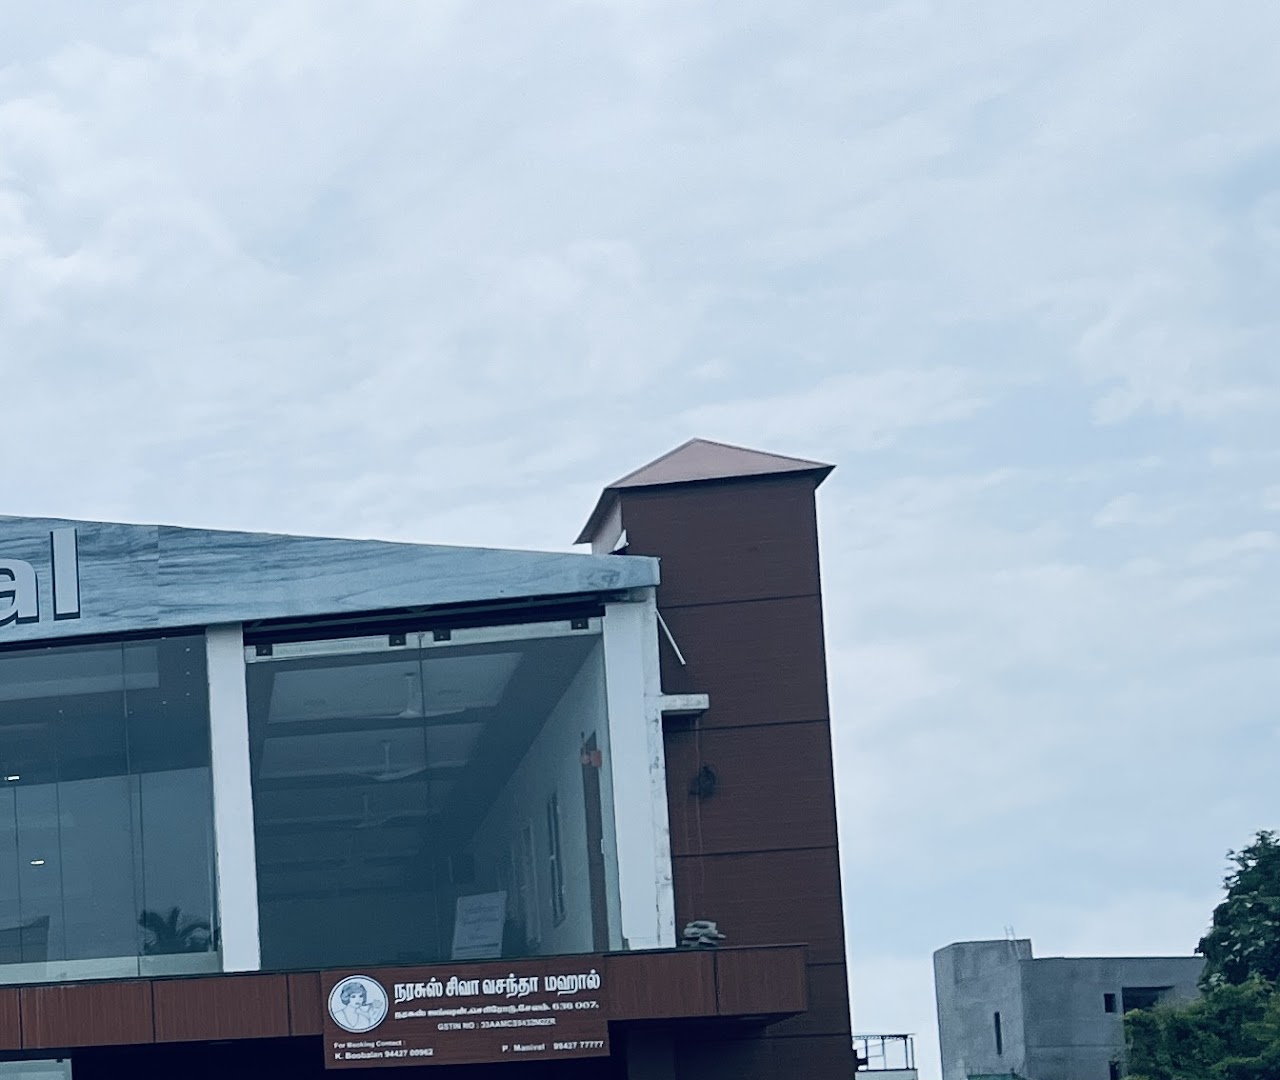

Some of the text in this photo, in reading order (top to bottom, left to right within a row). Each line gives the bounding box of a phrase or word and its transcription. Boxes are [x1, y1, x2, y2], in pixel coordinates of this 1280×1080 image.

[446, 976, 479, 997] சிவா
[482, 973, 538, 999] வசந்தா
[544, 969, 601, 996] மஹால்
